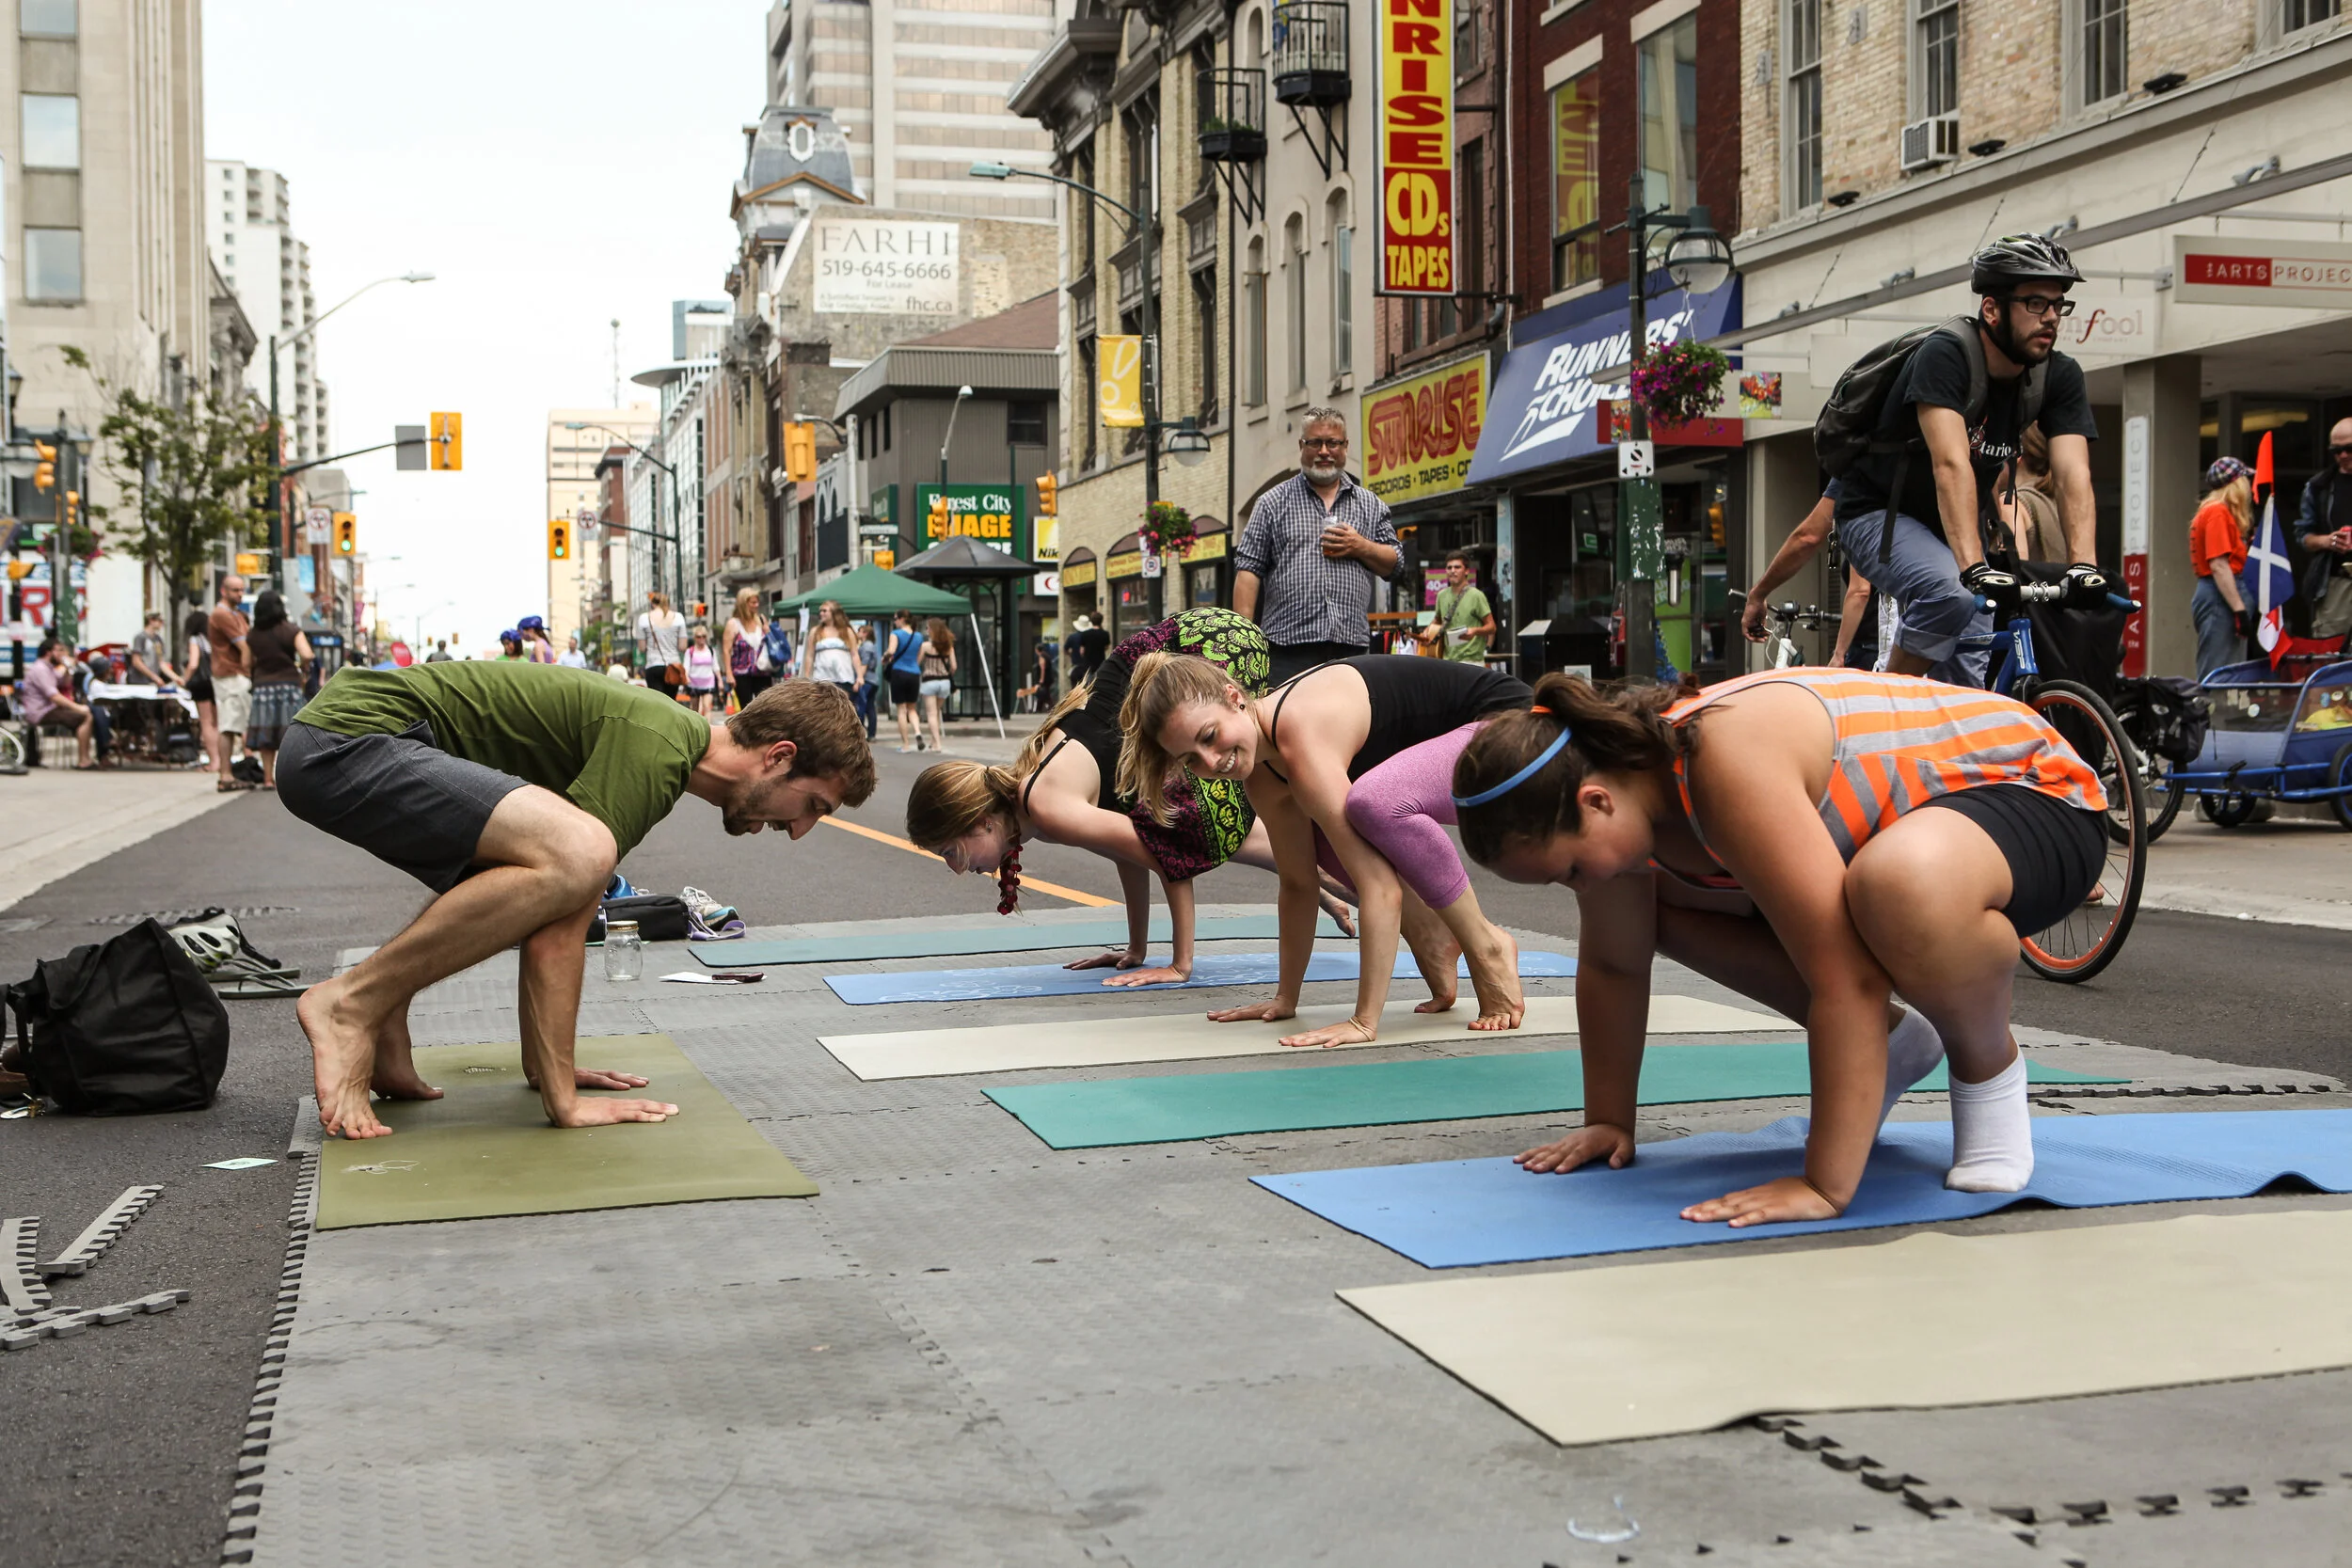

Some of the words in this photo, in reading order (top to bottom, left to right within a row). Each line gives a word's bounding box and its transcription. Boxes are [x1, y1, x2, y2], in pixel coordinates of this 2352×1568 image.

[1386, 171, 1450, 237] CDs
[820, 227, 949, 256] FARHI
[822, 260, 951, 279] 519-645-6666
[1387, 245, 1450, 288] TAPES
[2216, 262, 2267, 280] ARTS
[906, 296, 952, 312] fhc.ca
[1979, 441, 2011, 457] tario
[1419, 465, 1449, 483] TAPES
[2130, 421, 2142, 550] PROJECT
[929, 494, 979, 511] Frest
[982, 494, 1011, 514] City
[1038, 548, 1058, 559] Nik
[2128, 562, 2140, 635] ATS
